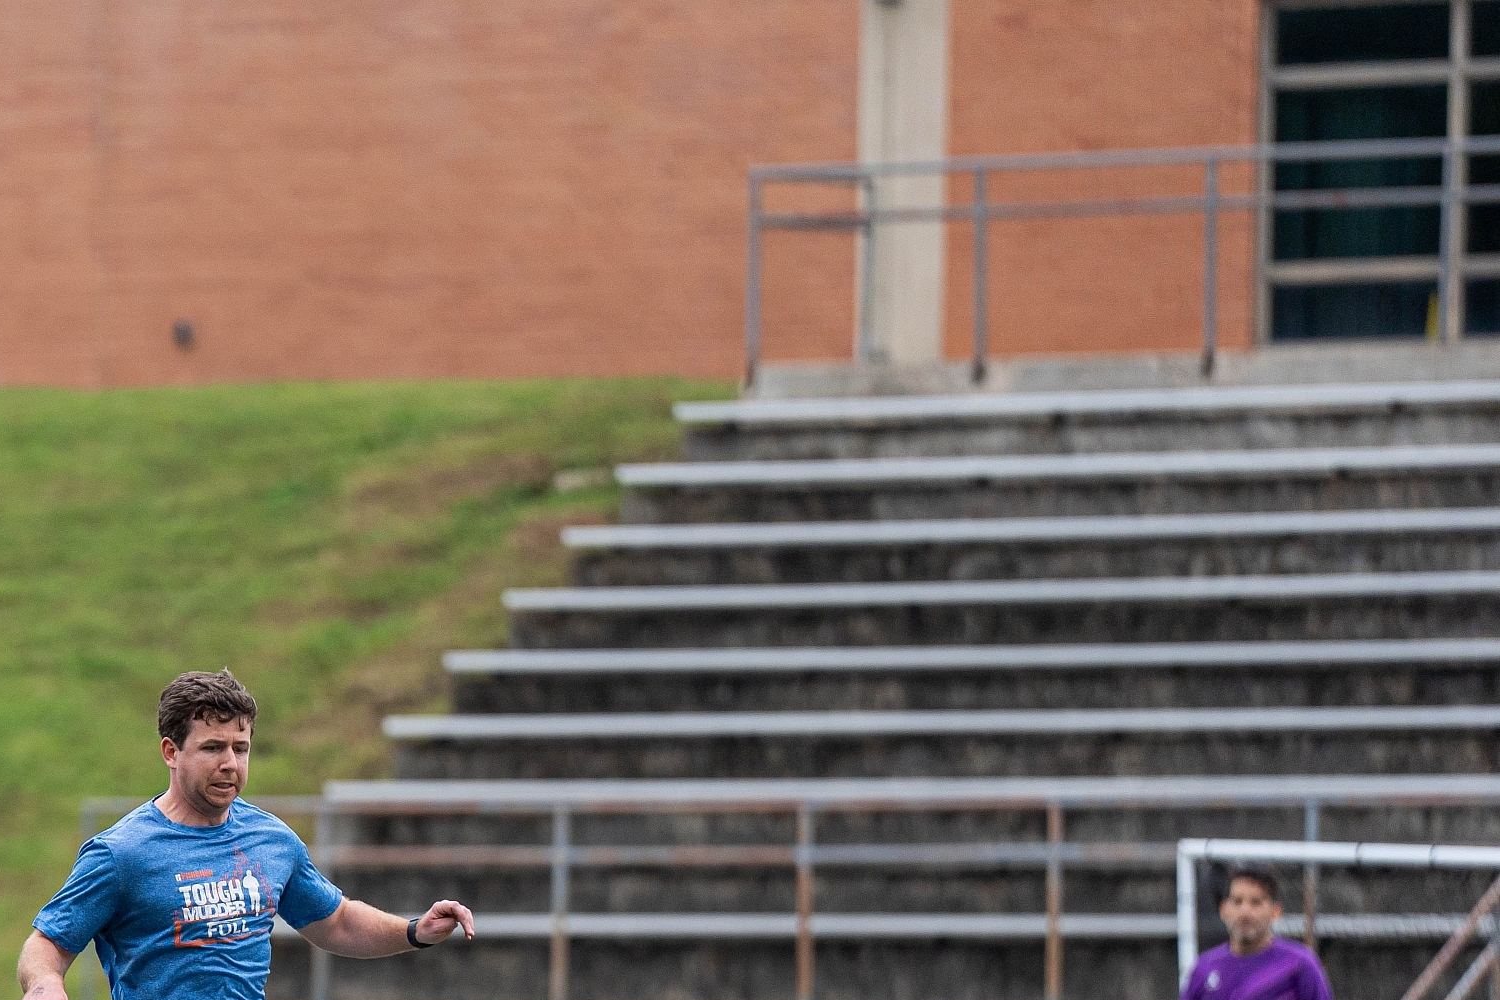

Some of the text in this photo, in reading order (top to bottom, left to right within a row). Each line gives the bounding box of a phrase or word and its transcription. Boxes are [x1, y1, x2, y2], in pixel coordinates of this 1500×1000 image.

[179, 879, 245, 907] TOUGH
[182, 901, 247, 922] MUDDER
[206, 918, 250, 938] FULL
